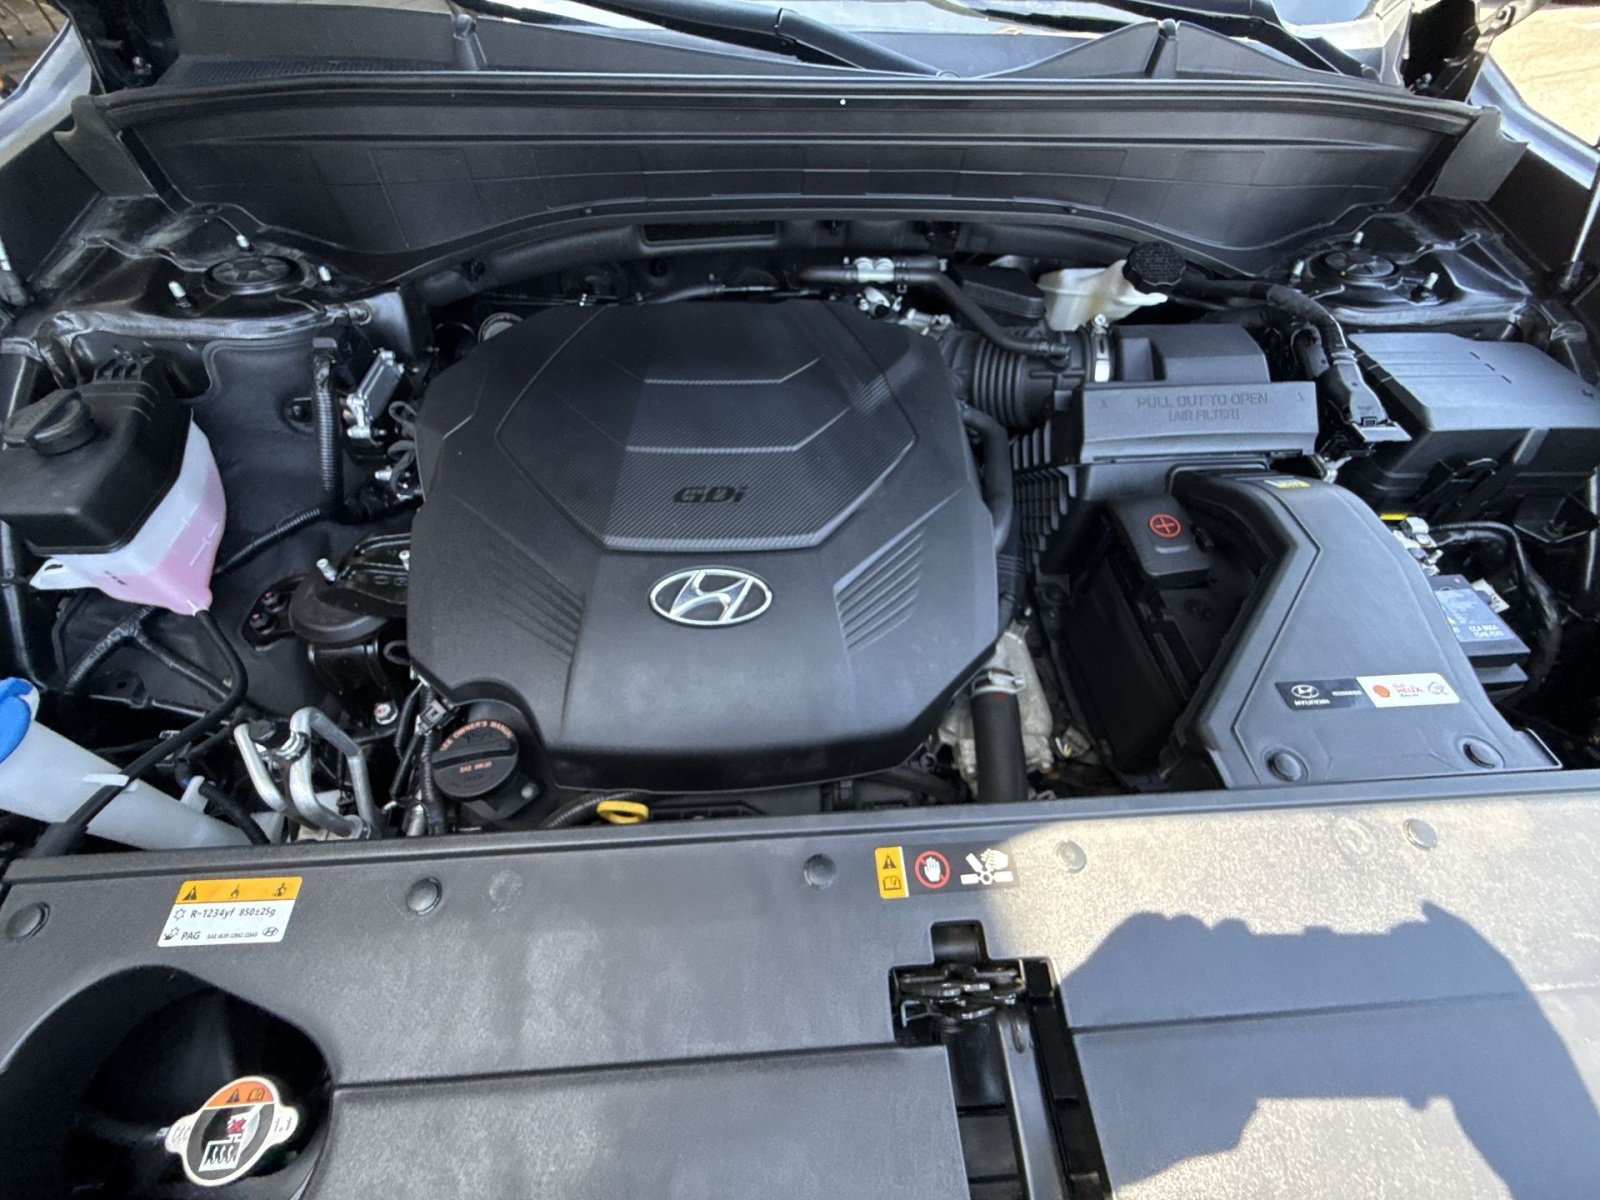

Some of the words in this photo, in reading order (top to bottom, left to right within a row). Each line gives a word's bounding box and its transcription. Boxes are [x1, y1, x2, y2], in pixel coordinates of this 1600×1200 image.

[1137, 396, 1172, 408] PULL
[1177, 395, 1207, 407] OUT
[1208, 394, 1228, 406] TO
[1230, 392, 1268, 405] OPEN
[190, 907, 236, 919] R-1234yf
[181, 931, 201, 940] PAG
